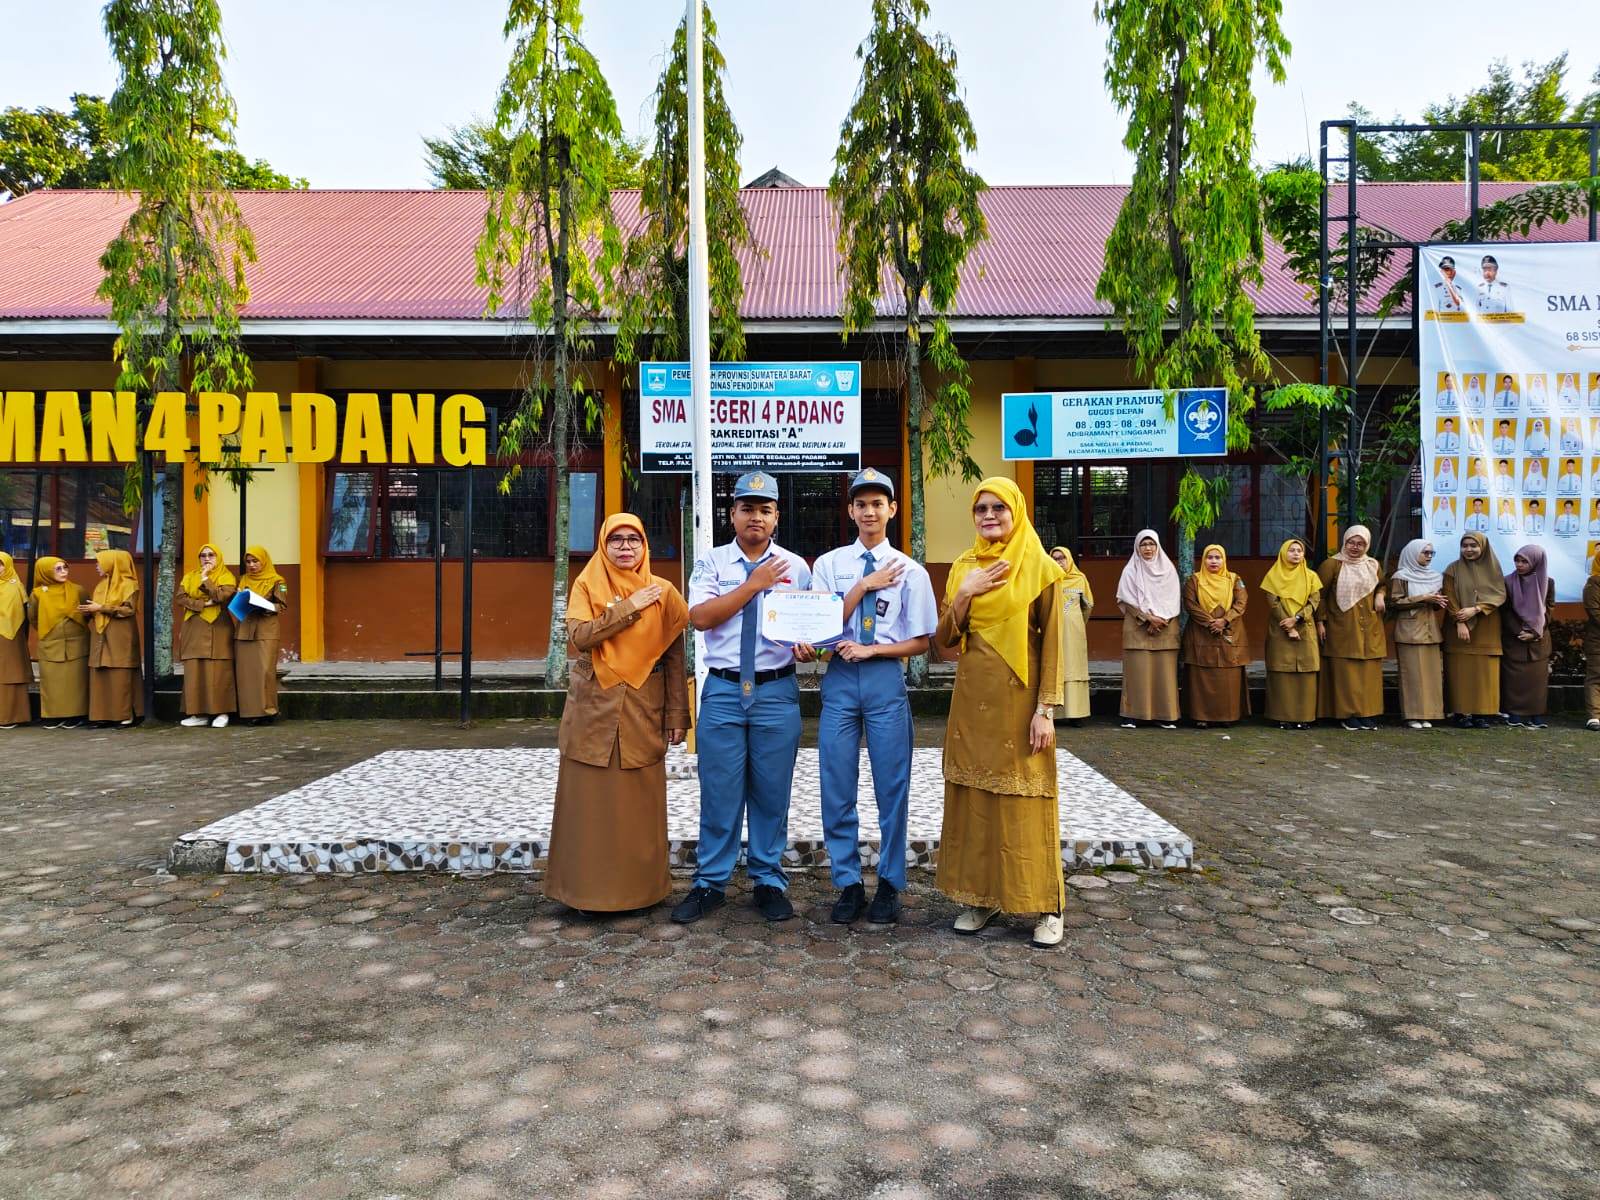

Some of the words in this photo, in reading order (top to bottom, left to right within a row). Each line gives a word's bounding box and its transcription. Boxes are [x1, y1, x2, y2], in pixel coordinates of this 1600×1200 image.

[1547, 295, 1592, 311] SMA
[1566, 331, 1580, 341] 68
[1581, 331, 1600, 341] SIS
[718, 370, 749, 379] PROVINSI
[751, 370, 788, 379] SUMATERA
[789, 370, 812, 379] BARAT
[732, 381, 774, 390] PENDIDIKAN
[1062, 397, 1113, 407] GERAKAN
[1116, 395, 1164, 406] PRAMUK
[652, 399, 686, 424] SMA
[762, 399, 771, 424] 4
[776, 400, 844, 425] PADANG
[1088, 408, 1115, 416] GUGUS
[782, 427, 803, 439] "A"
